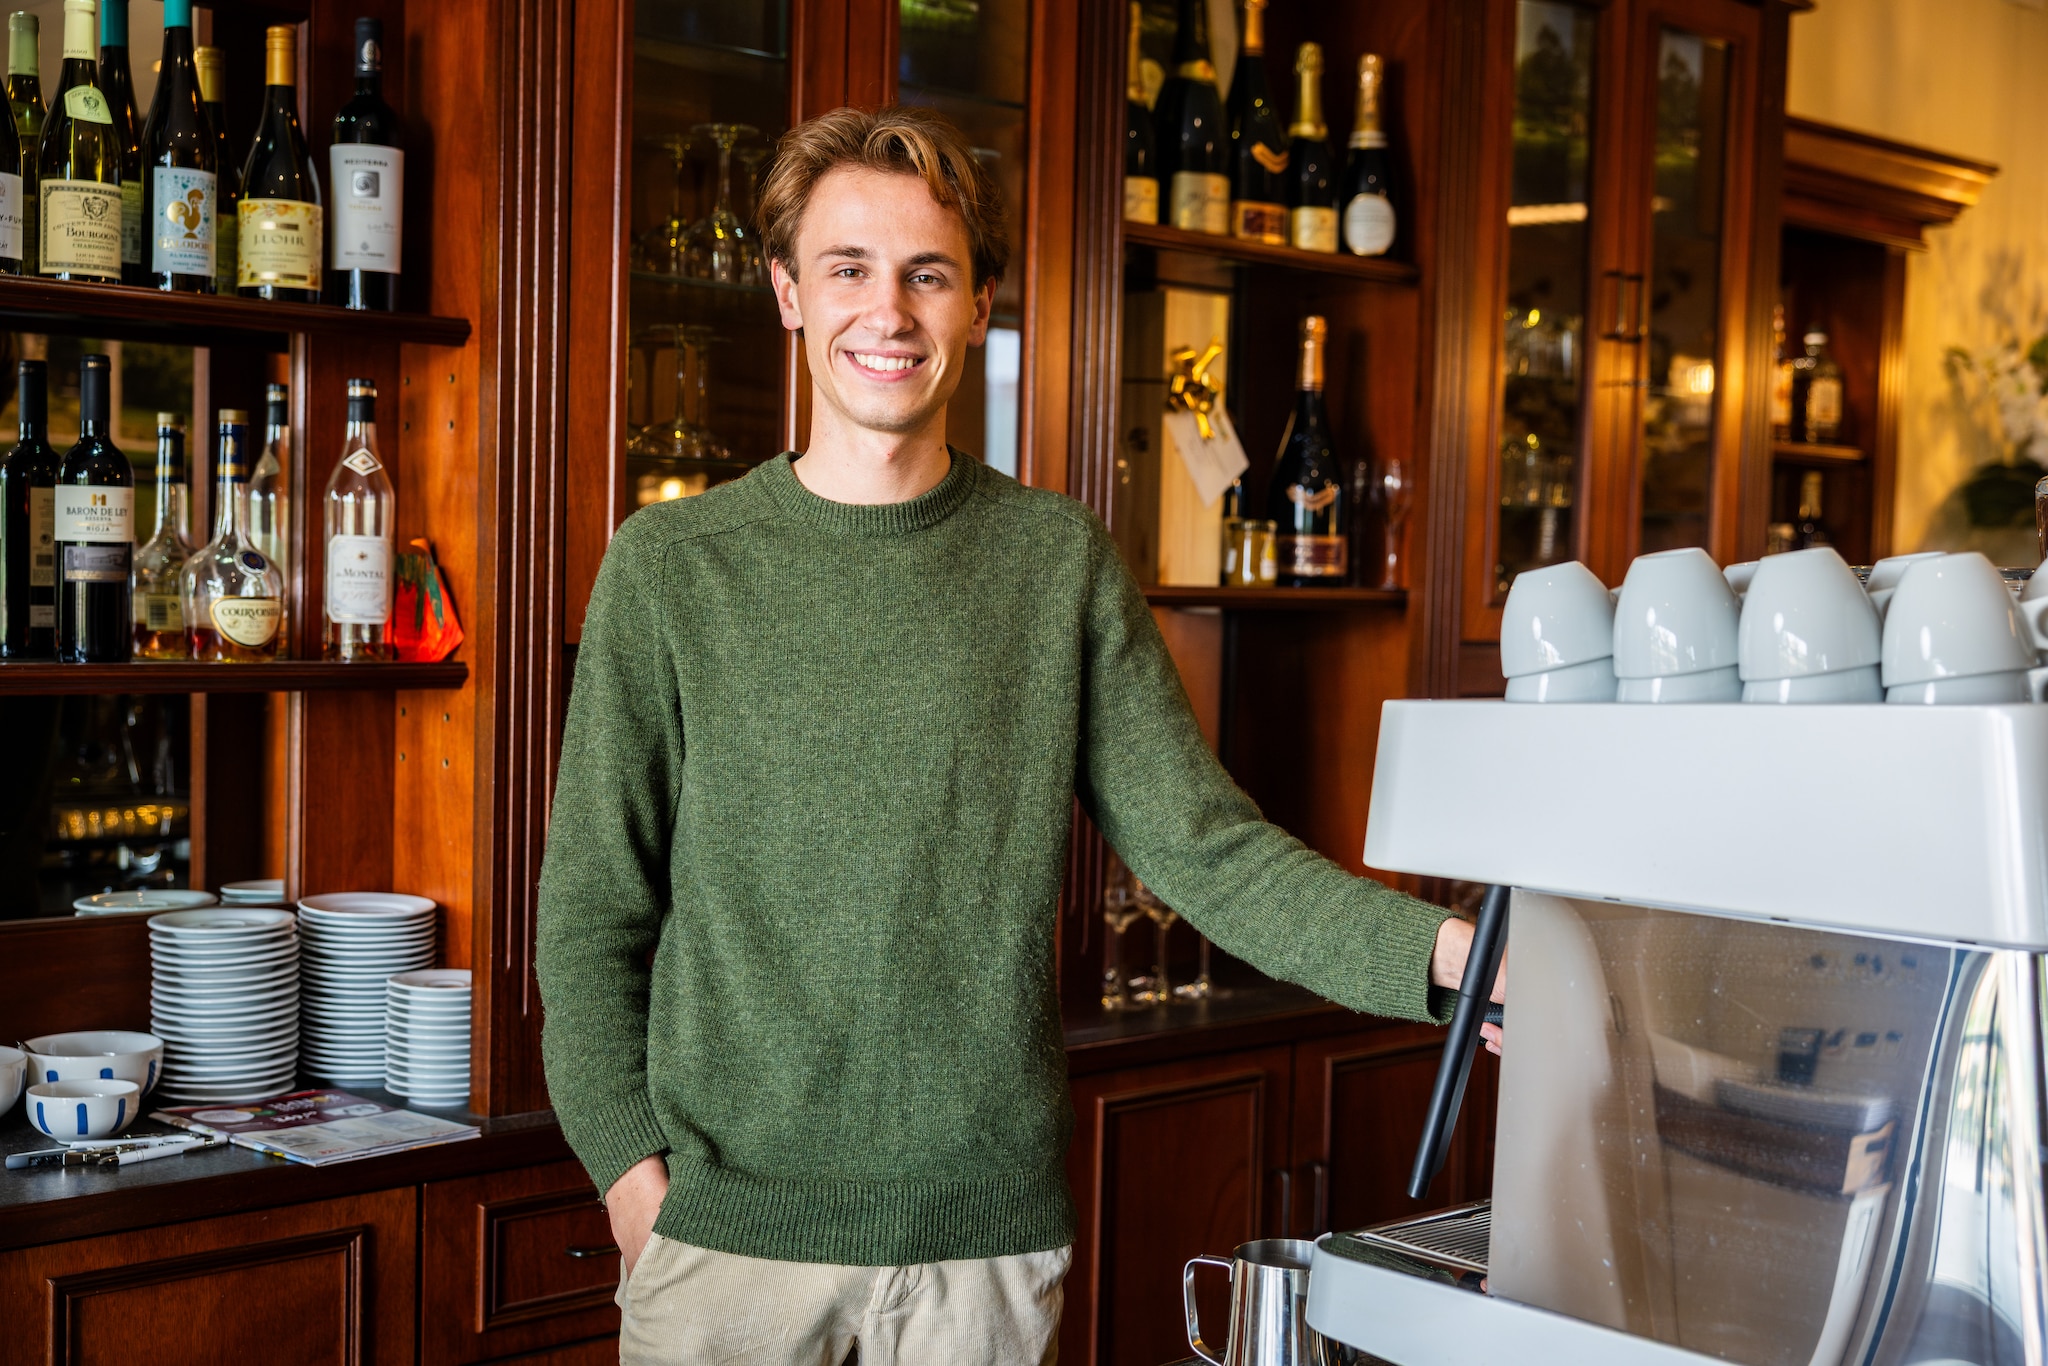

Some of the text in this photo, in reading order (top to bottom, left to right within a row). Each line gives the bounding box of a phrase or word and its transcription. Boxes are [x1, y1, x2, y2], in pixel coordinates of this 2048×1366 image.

[66, 507, 129, 518] BARON DE LEY
[86, 525, 110, 533] RIOJA
[343, 567, 385, 579] MONTAL
